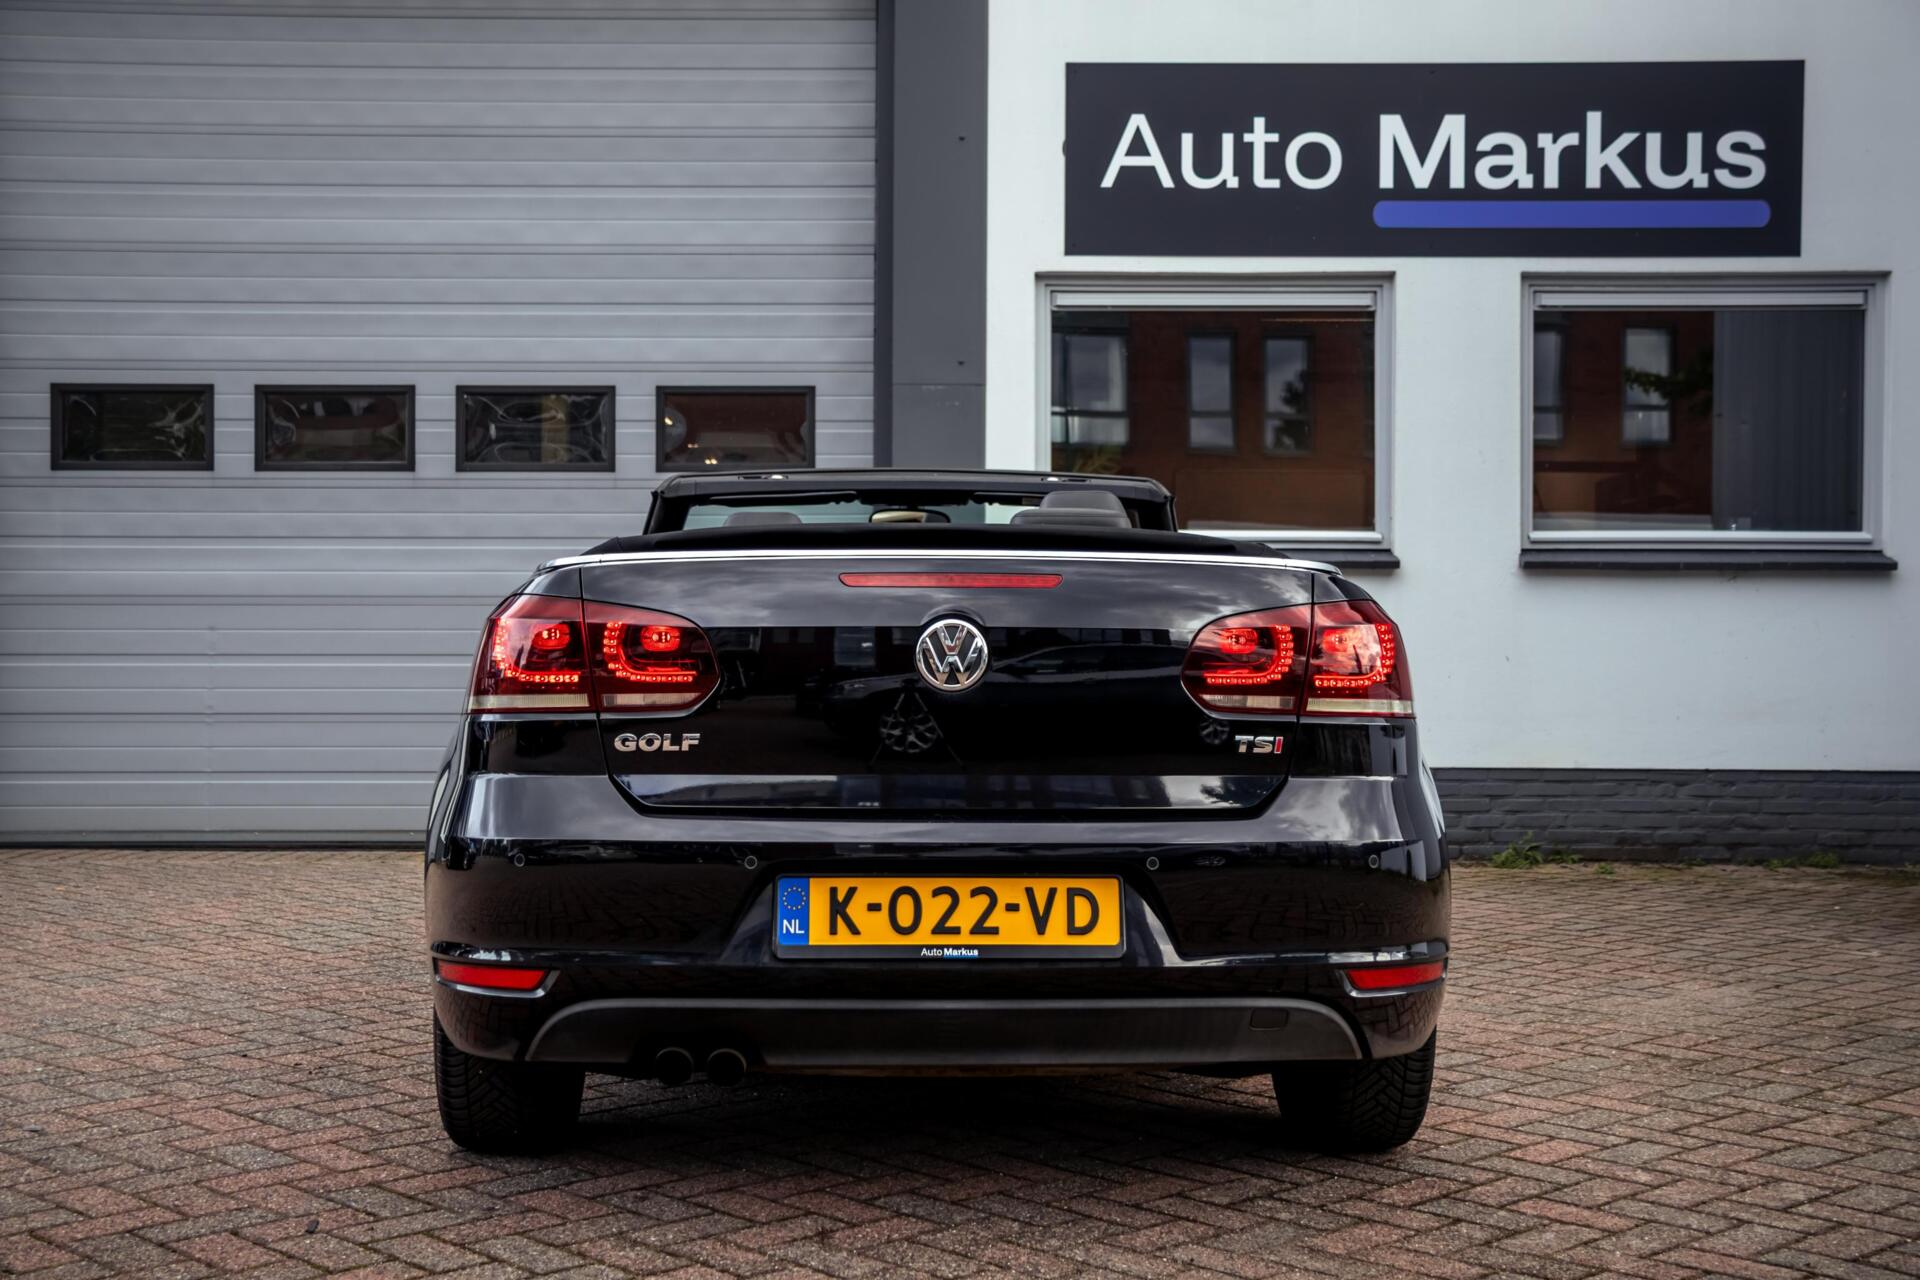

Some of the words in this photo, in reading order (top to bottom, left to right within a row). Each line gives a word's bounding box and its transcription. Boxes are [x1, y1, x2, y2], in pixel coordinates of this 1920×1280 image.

[1100, 113, 1343, 190] Auto
[1378, 110, 1768, 190] Markus
[614, 733, 701, 752] GOLF
[1235, 735, 1284, 754] TSI
[828, 886, 1100, 935] K-022-VD
[782, 919, 805, 934] NL
[921, 947, 943, 956] Auto
[943, 947, 979, 957] Markus
